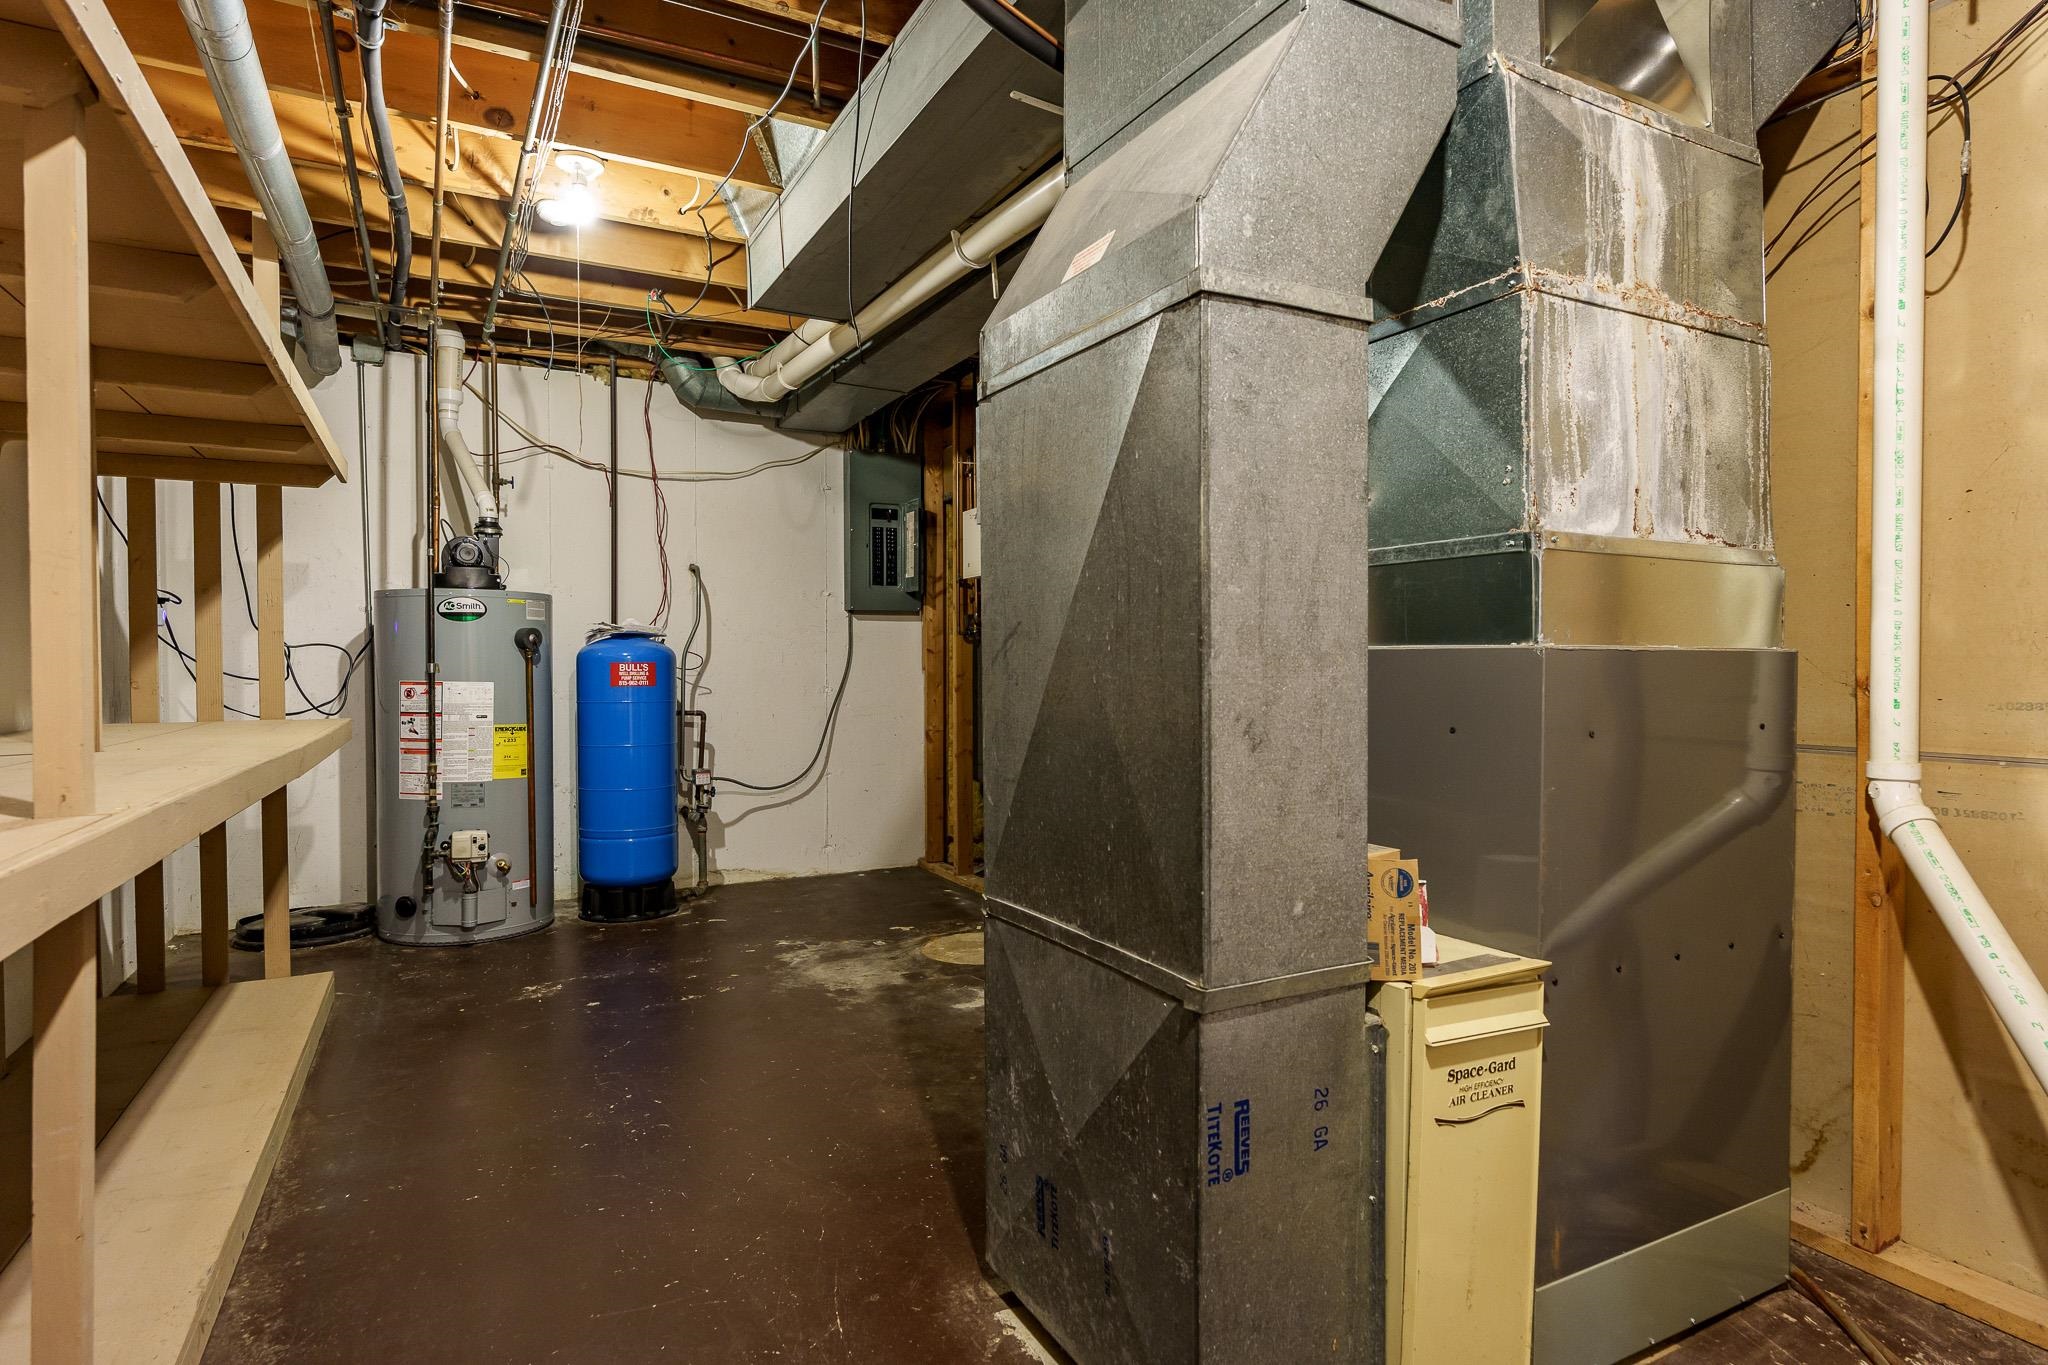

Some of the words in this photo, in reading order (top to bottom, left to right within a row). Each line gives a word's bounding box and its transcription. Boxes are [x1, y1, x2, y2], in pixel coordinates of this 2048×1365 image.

[1399, 913, 1407, 955] REPLACEMENT
[1407, 923, 1417, 947] Model
[1408, 948, 1417, 961] No.
[1408, 963, 1417, 974] 201
[1447, 1056, 1516, 1084] Space-Gard
[1448, 1095, 1466, 1108] AIR
[1470, 1084, 1514, 1103] CLEANER
[1459, 1085, 1473, 1093] HIGH
[1474, 1077, 1504, 1091] EFFICIENCY
[1314, 1087, 1329, 1111] 26
[1233, 1099, 1250, 1176] REEVES
[1314, 1126, 1329, 1152] GA
